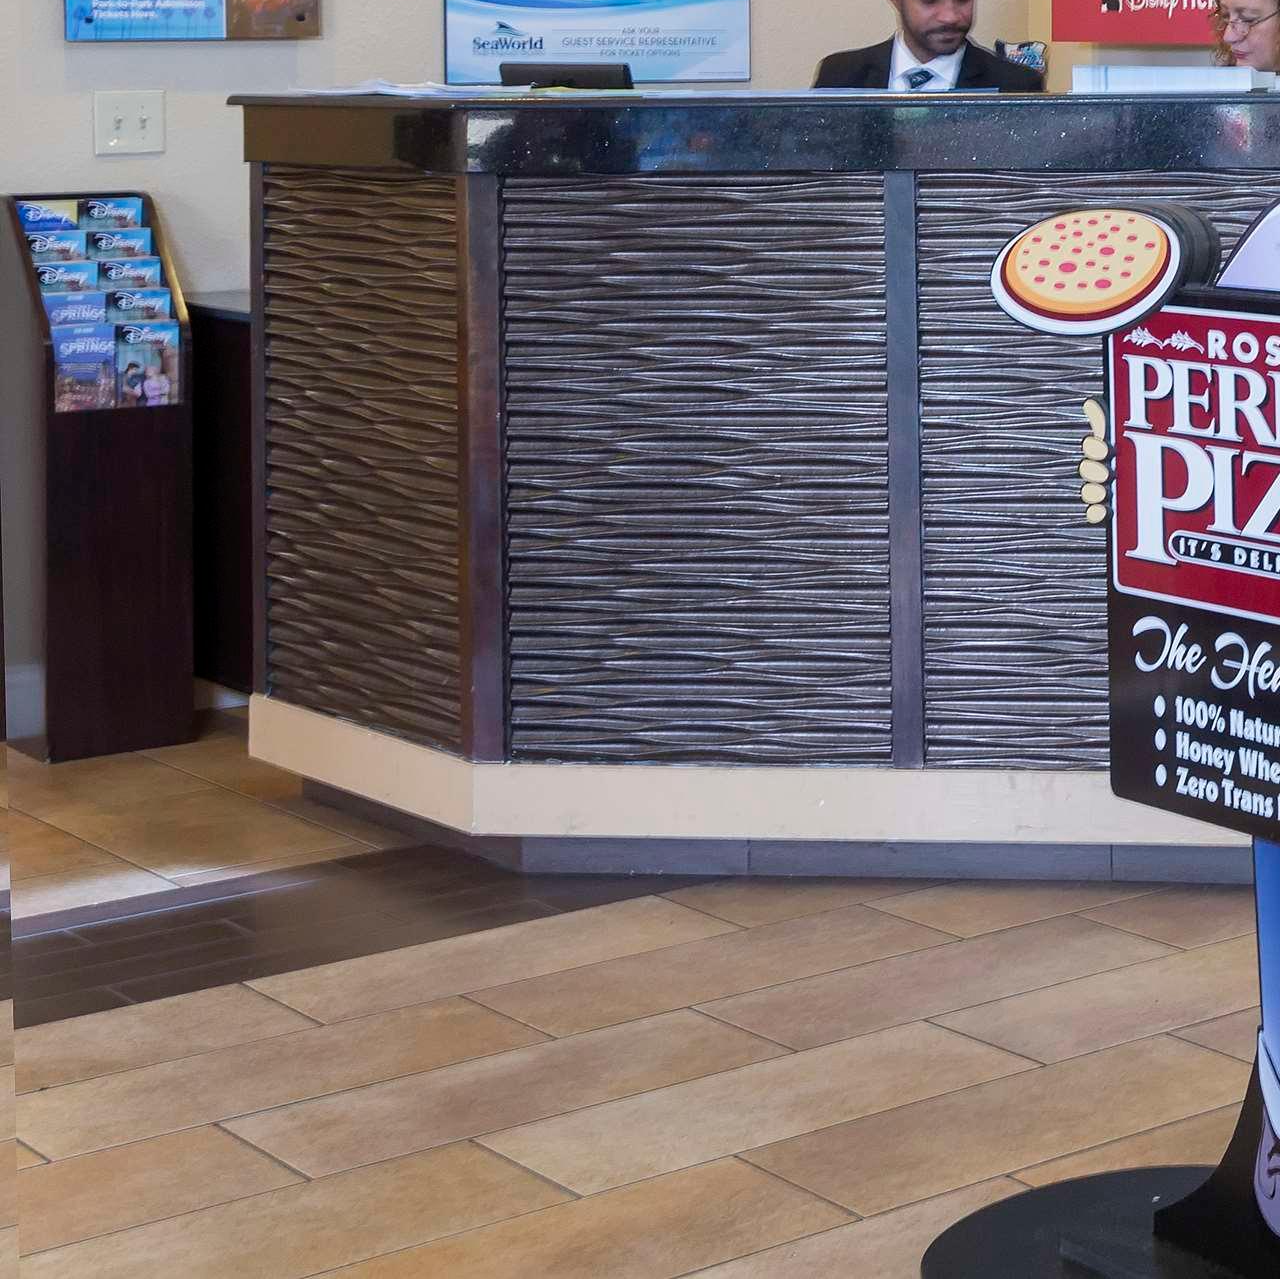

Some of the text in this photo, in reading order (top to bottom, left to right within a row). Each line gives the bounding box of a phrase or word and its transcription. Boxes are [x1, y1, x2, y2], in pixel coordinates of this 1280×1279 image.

[472, 36, 544, 51] SeaWorld
[1178, 536, 1223, 562] IT'S
[1132, 615, 1207, 677] The
[1175, 695, 1226, 734] 100%
[1175, 730, 1236, 776] Honey
[1175, 766, 1219, 803] Zero
[1220, 778, 1274, 819] Trans
